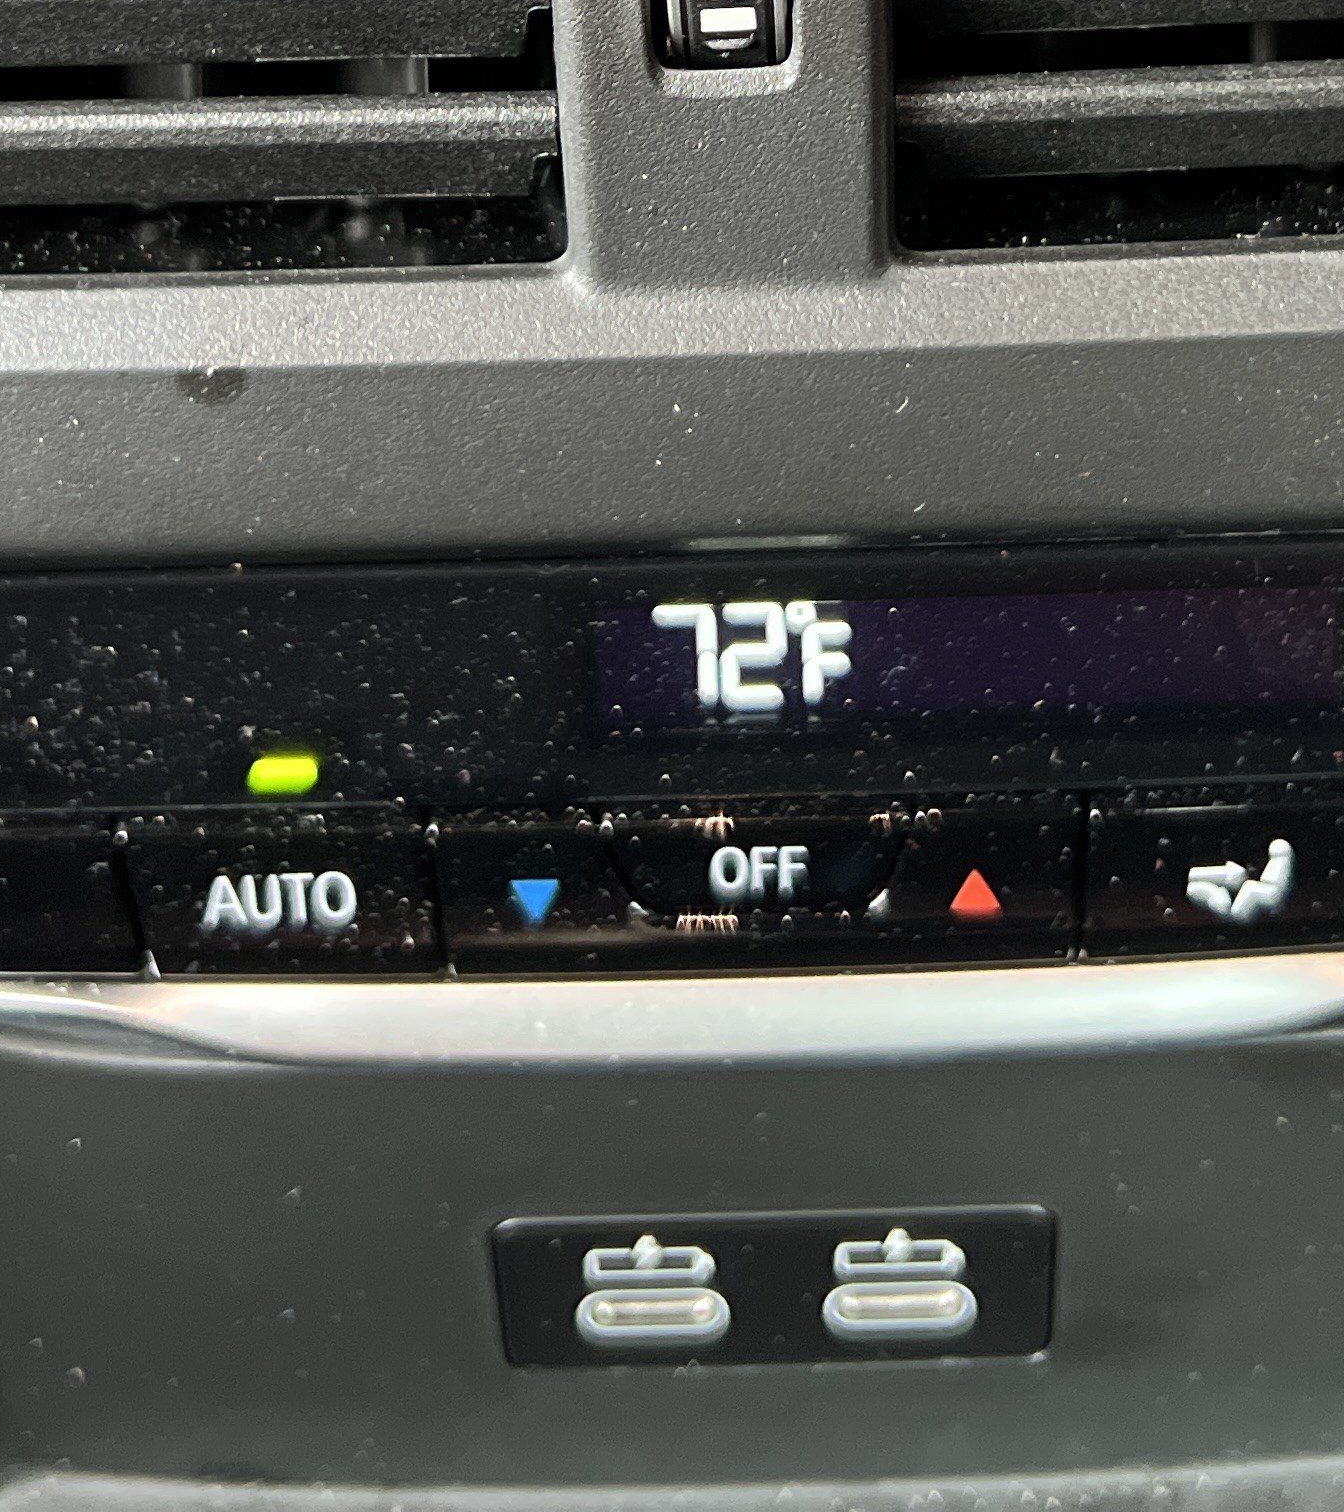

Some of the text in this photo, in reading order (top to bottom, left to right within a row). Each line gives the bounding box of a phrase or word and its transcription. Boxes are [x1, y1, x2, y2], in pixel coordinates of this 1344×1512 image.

[651, 600, 853, 713] 72°F
[201, 870, 358, 931] AUTO
[709, 844, 809, 897] OFF
